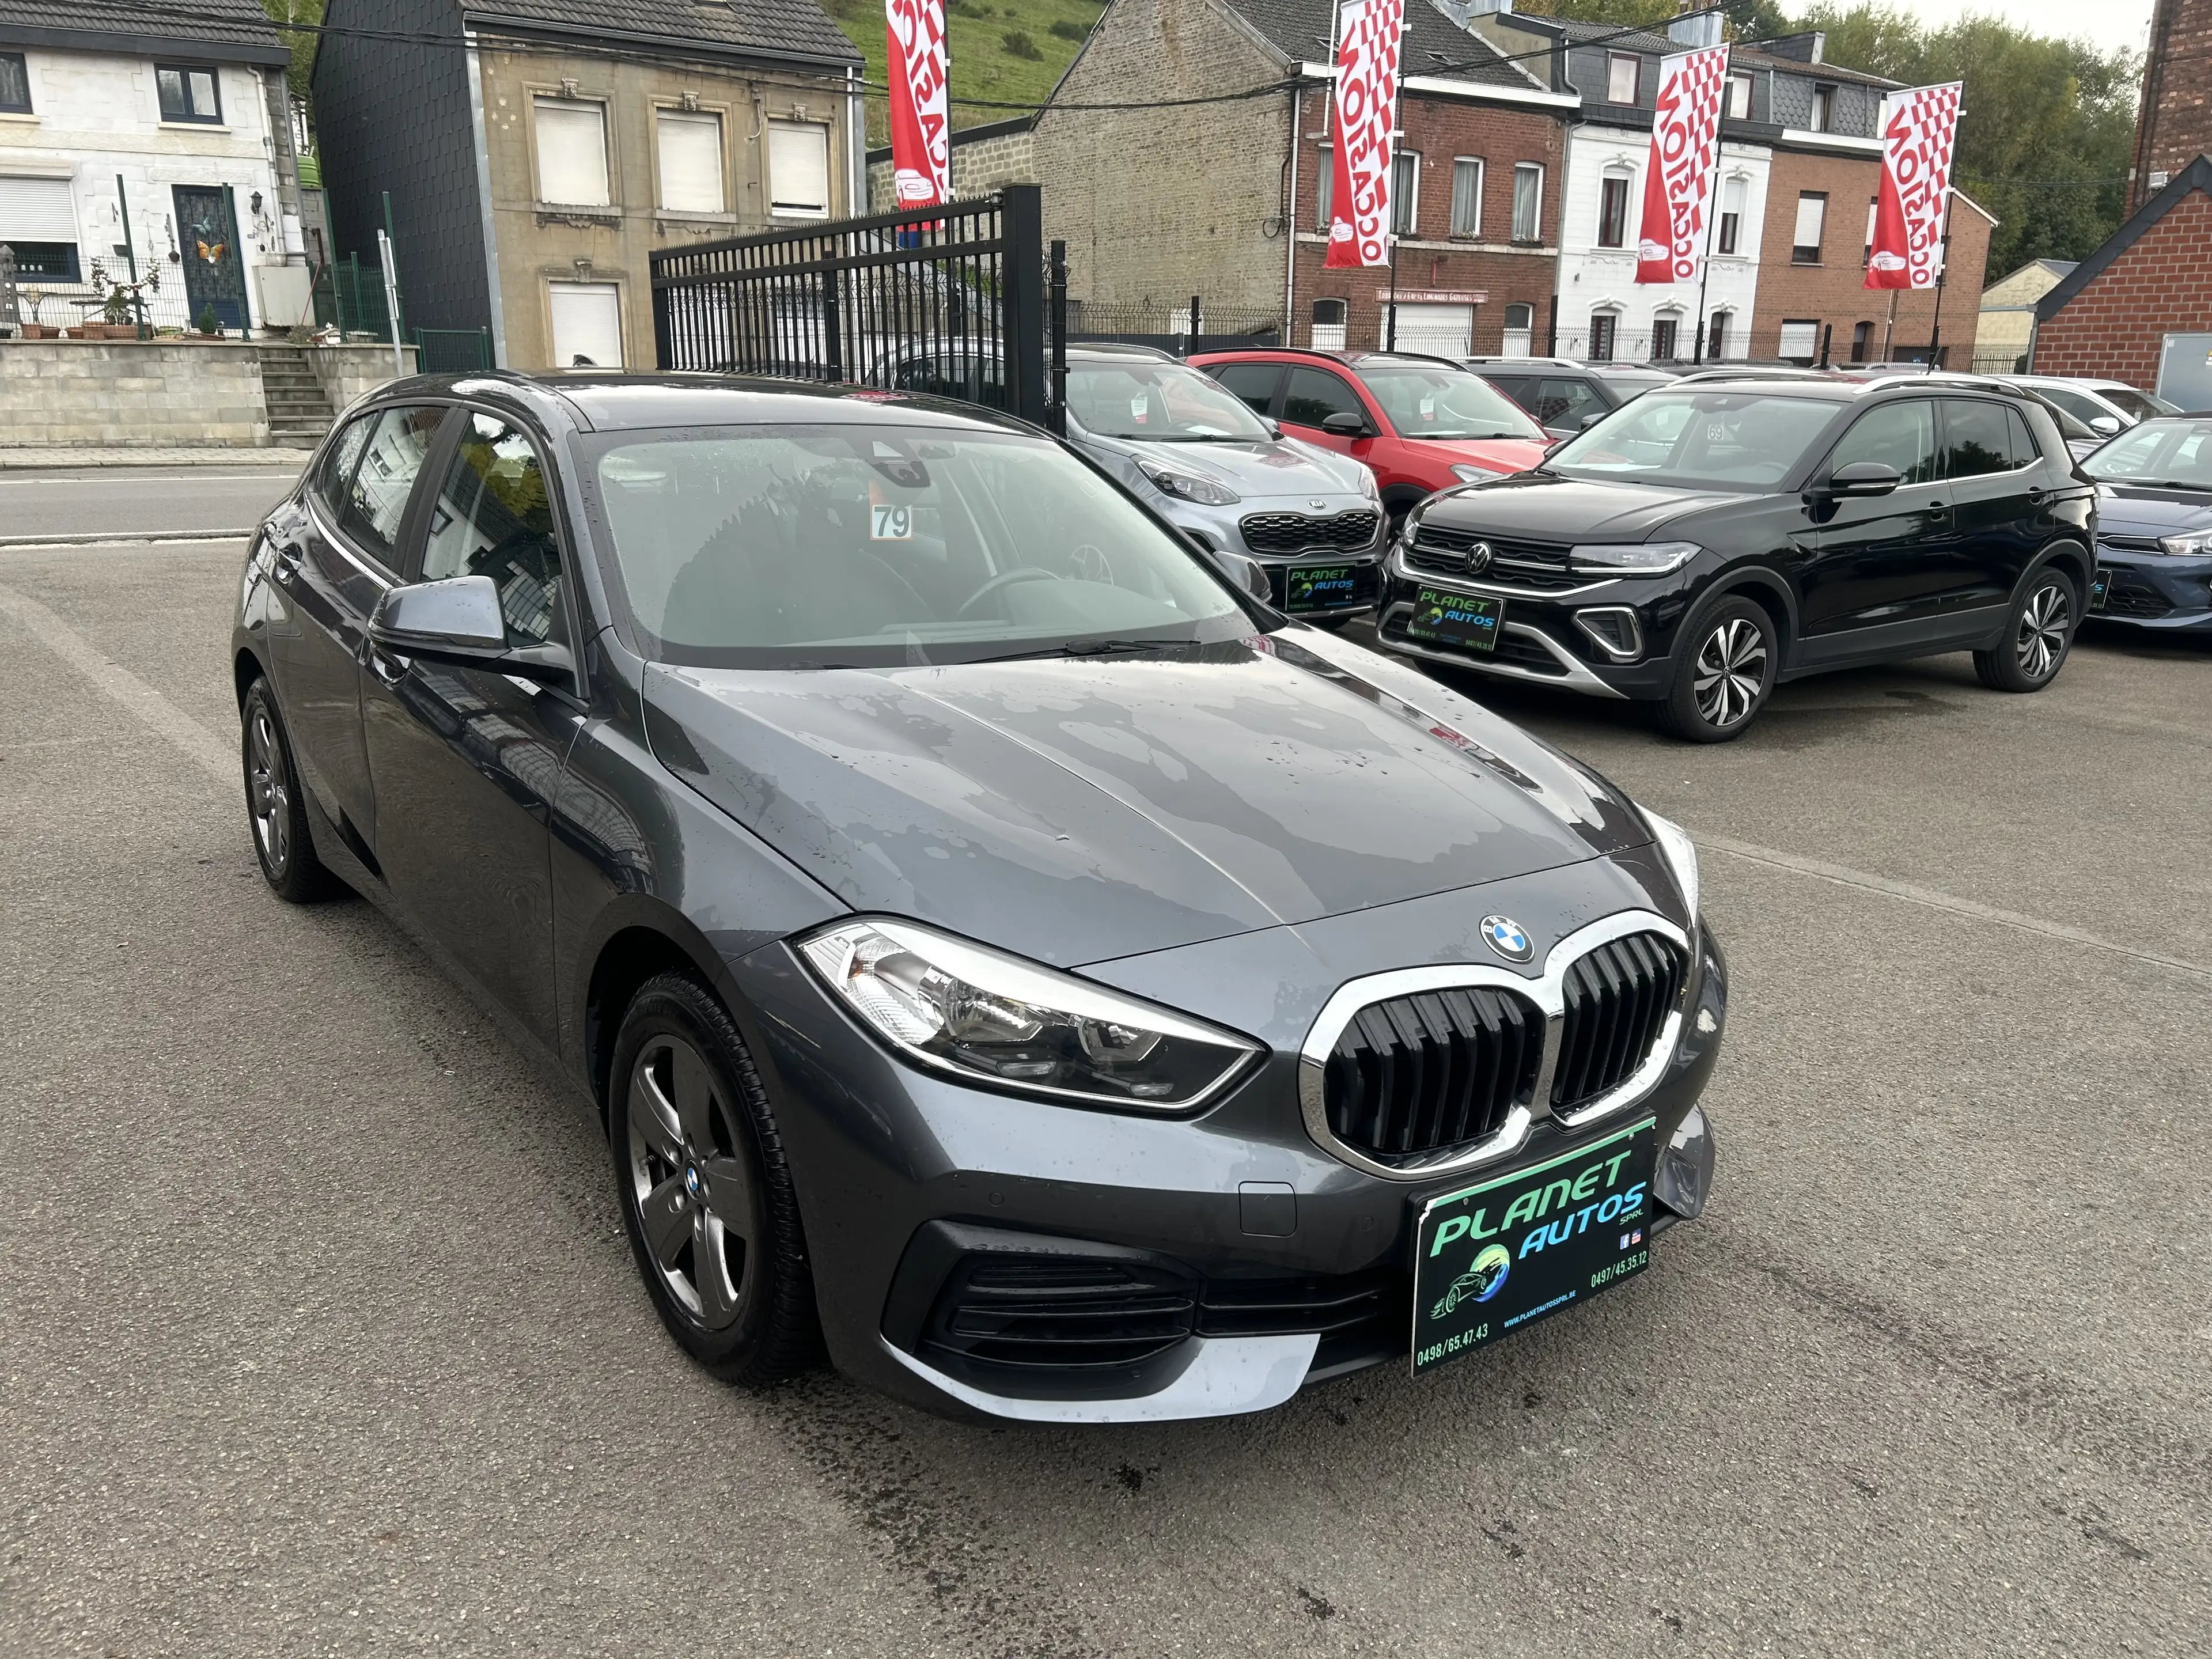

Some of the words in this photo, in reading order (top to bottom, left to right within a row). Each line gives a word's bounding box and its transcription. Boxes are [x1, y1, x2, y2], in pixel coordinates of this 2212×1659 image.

[1709, 425, 1722, 439] 69
[874, 506, 910, 537] 79
[1290, 569, 1348, 581] PLANET
[1315, 580, 1354, 590] AUTOS
[1419, 591, 1489, 613] PLANET
[1444, 611, 1495, 627] AUTOS
[1483, 916, 1517, 934] BMW
[1430, 1150, 1631, 1258] PLANET
[1518, 1181, 1647, 1260] AUTOS
[1619, 1208, 1643, 1225] SPRL
[1590, 1251, 1647, 1288] 0497/45.35.12
[1504, 1290, 1576, 1328] WWW.PLANETAUTOSSPRL.BE
[1417, 1323, 1488, 1366] 0498/65.47.43
